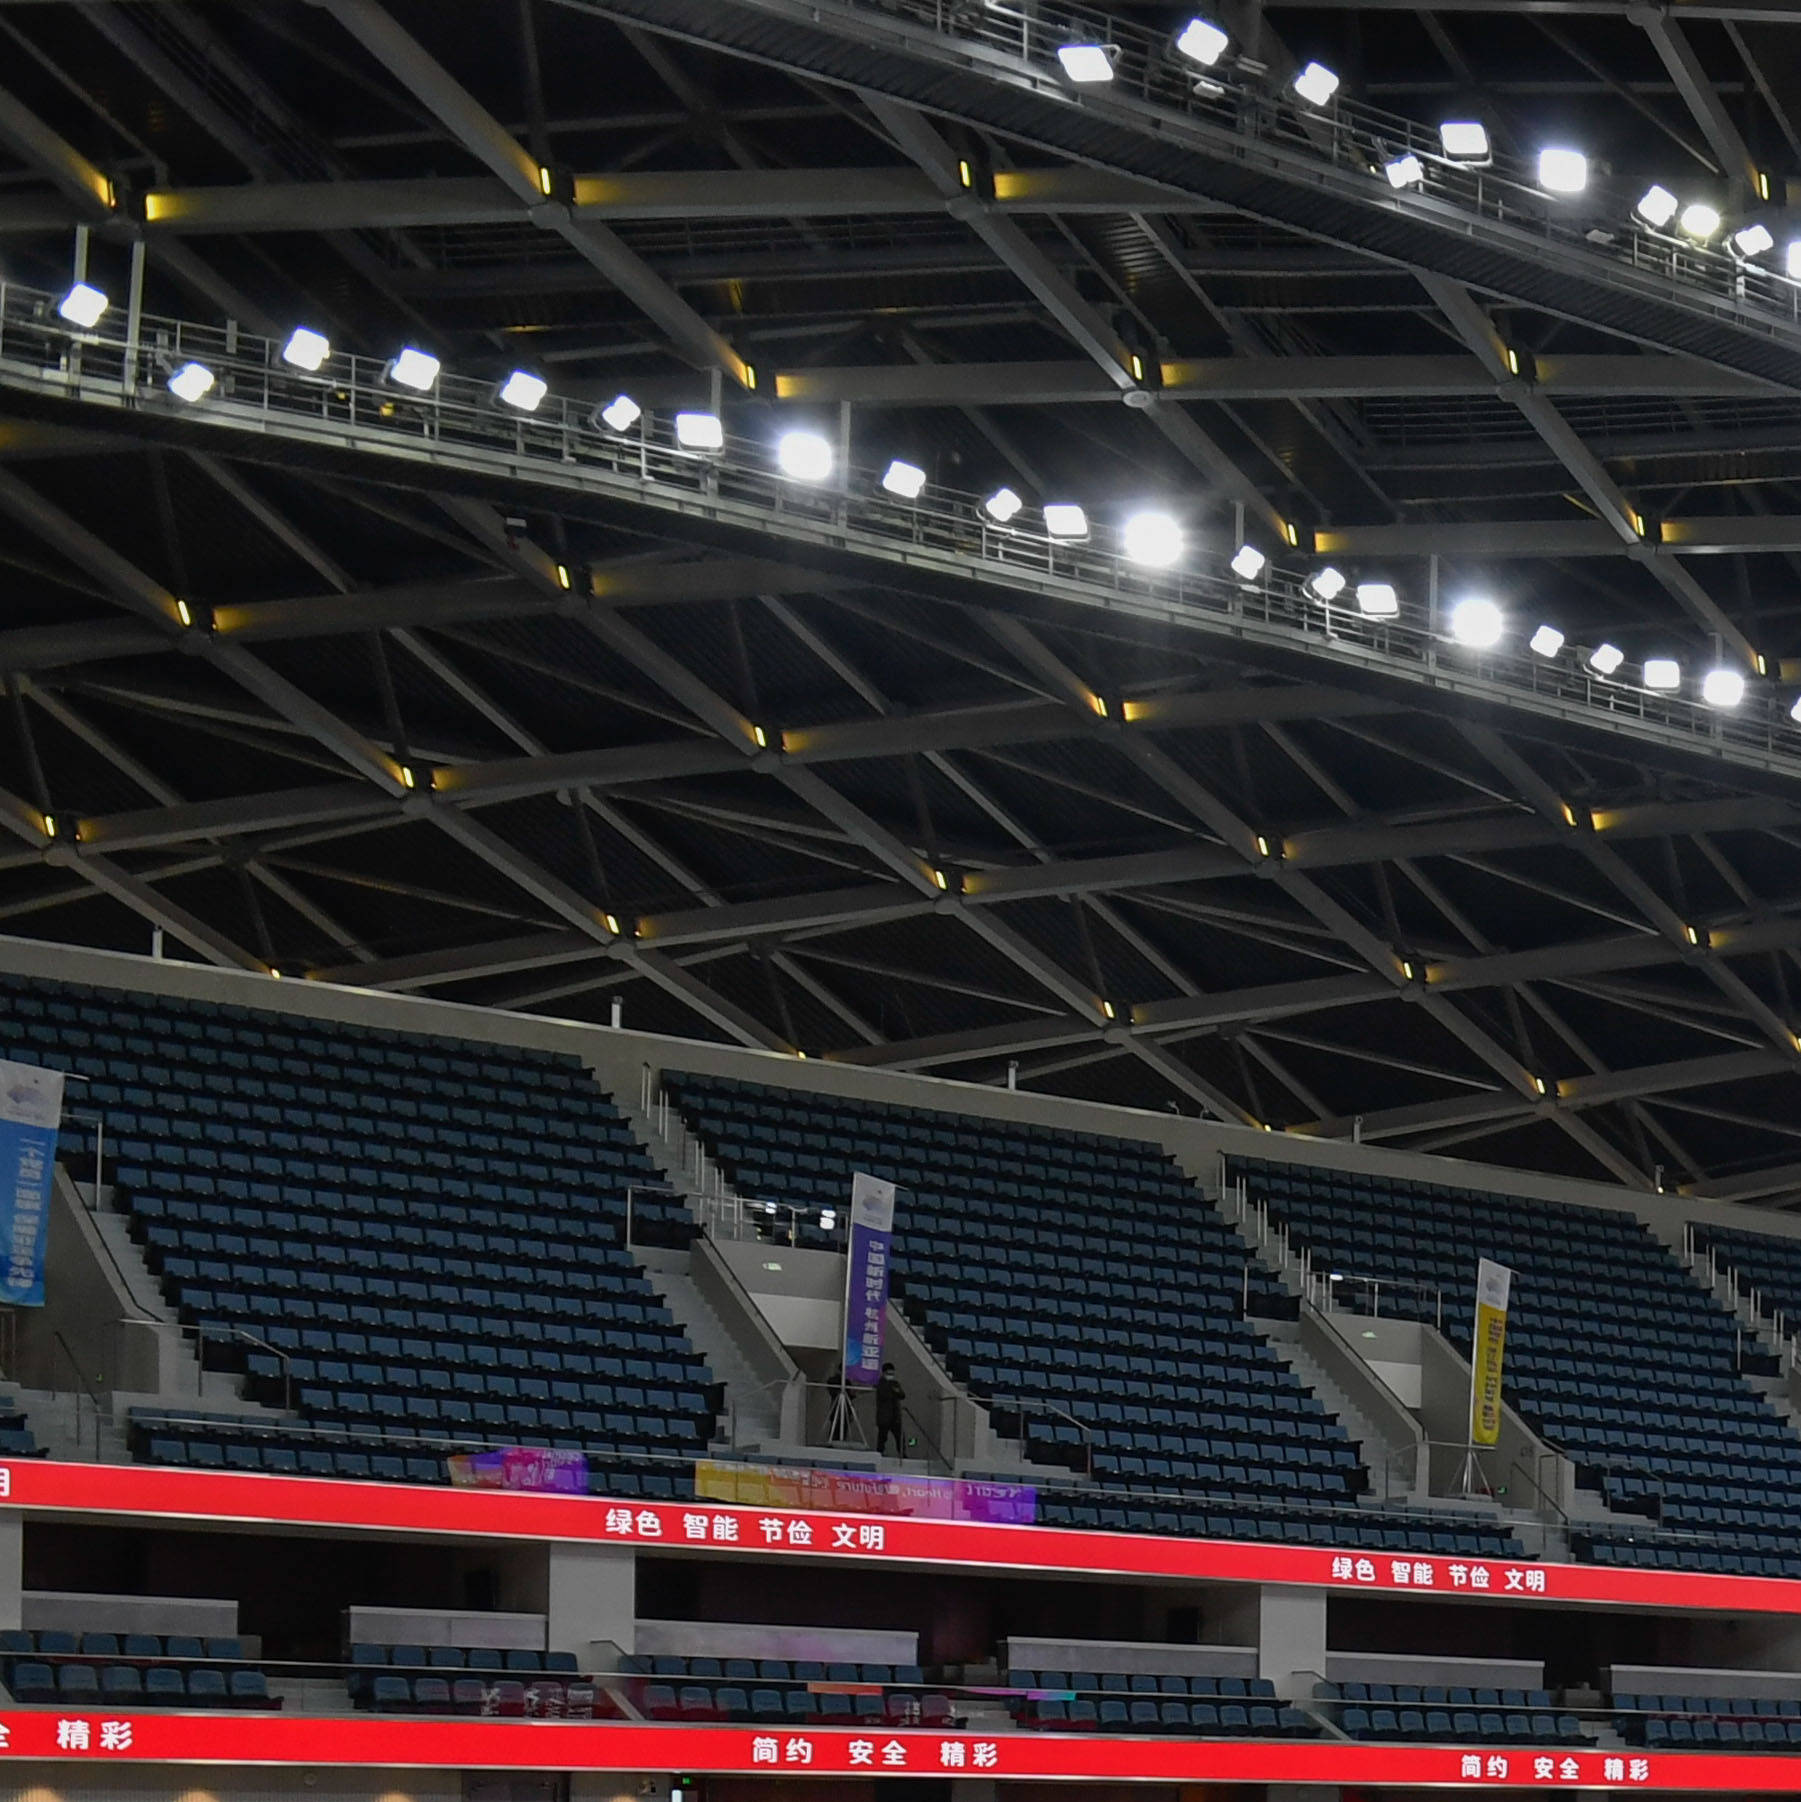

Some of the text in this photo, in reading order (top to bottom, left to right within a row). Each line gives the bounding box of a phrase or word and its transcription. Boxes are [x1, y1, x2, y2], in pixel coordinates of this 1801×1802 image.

[606, 1509, 661, 1537] 绿色
[684, 1514, 738, 1542] 智能
[832, 1523, 885, 1551] 文明
[1332, 1557, 1375, 1582] 绿色
[1392, 1560, 1433, 1585] 智能
[1505, 1568, 1545, 1593] 文明
[57, 1720, 133, 1750] 精彩
[753, 1737, 998, 1767] 简约 安全 精彩
[1461, 1755, 1650, 1782] 简约 安全 精彩
